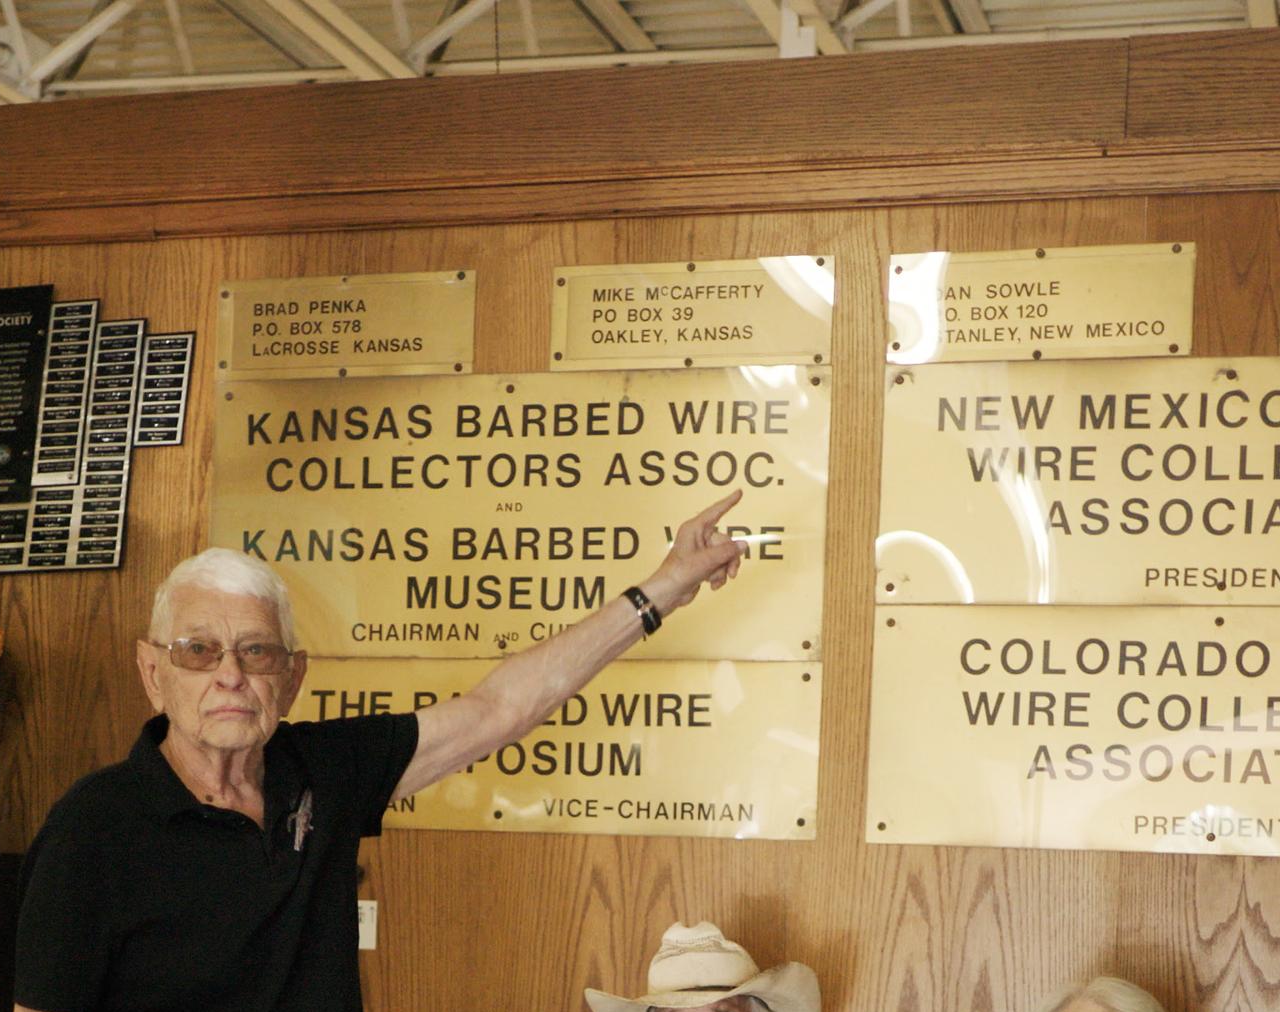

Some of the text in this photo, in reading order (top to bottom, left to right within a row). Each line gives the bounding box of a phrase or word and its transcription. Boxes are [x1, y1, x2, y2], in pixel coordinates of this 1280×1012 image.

[593, 287, 635, 302] MIKE
[986, 281, 1060, 299] SOWLE
[253, 300, 366, 316] BRAD PENKA
[593, 306, 694, 323] PO BOX 39
[971, 306, 1008, 320] BOX
[1018, 304, 1048, 319] 120
[253, 319, 362, 336] P.O. BOX 578
[591, 326, 753, 344] OAKLEY, KANSAS
[1030, 324, 1074, 340] NEW
[1086, 320, 1165, 338] MEXICO
[353, 337, 423, 352] KANSAS
[247, 400, 789, 445] KANSAS BARBED WIRE
[938, 395, 1054, 432] NEW
[266, 451, 784, 492] COLLECTORS ASSOC.
[966, 445, 1095, 484] WIRE
[496, 502, 523, 512] AND
[243, 528, 431, 562] KANSAS
[452, 526, 640, 561] BARBED
[406, 575, 606, 611] MUSEUM
[352, 623, 479, 641] CHAIRMAN
[493, 632, 519, 643] AND
[959, 638, 1271, 678] COLORADO
[312, 690, 393, 721] THE
[601, 693, 712, 727] WIRE
[961, 691, 1091, 728] WIRE
[543, 798, 754, 822] VICE-CHAIRMAN
